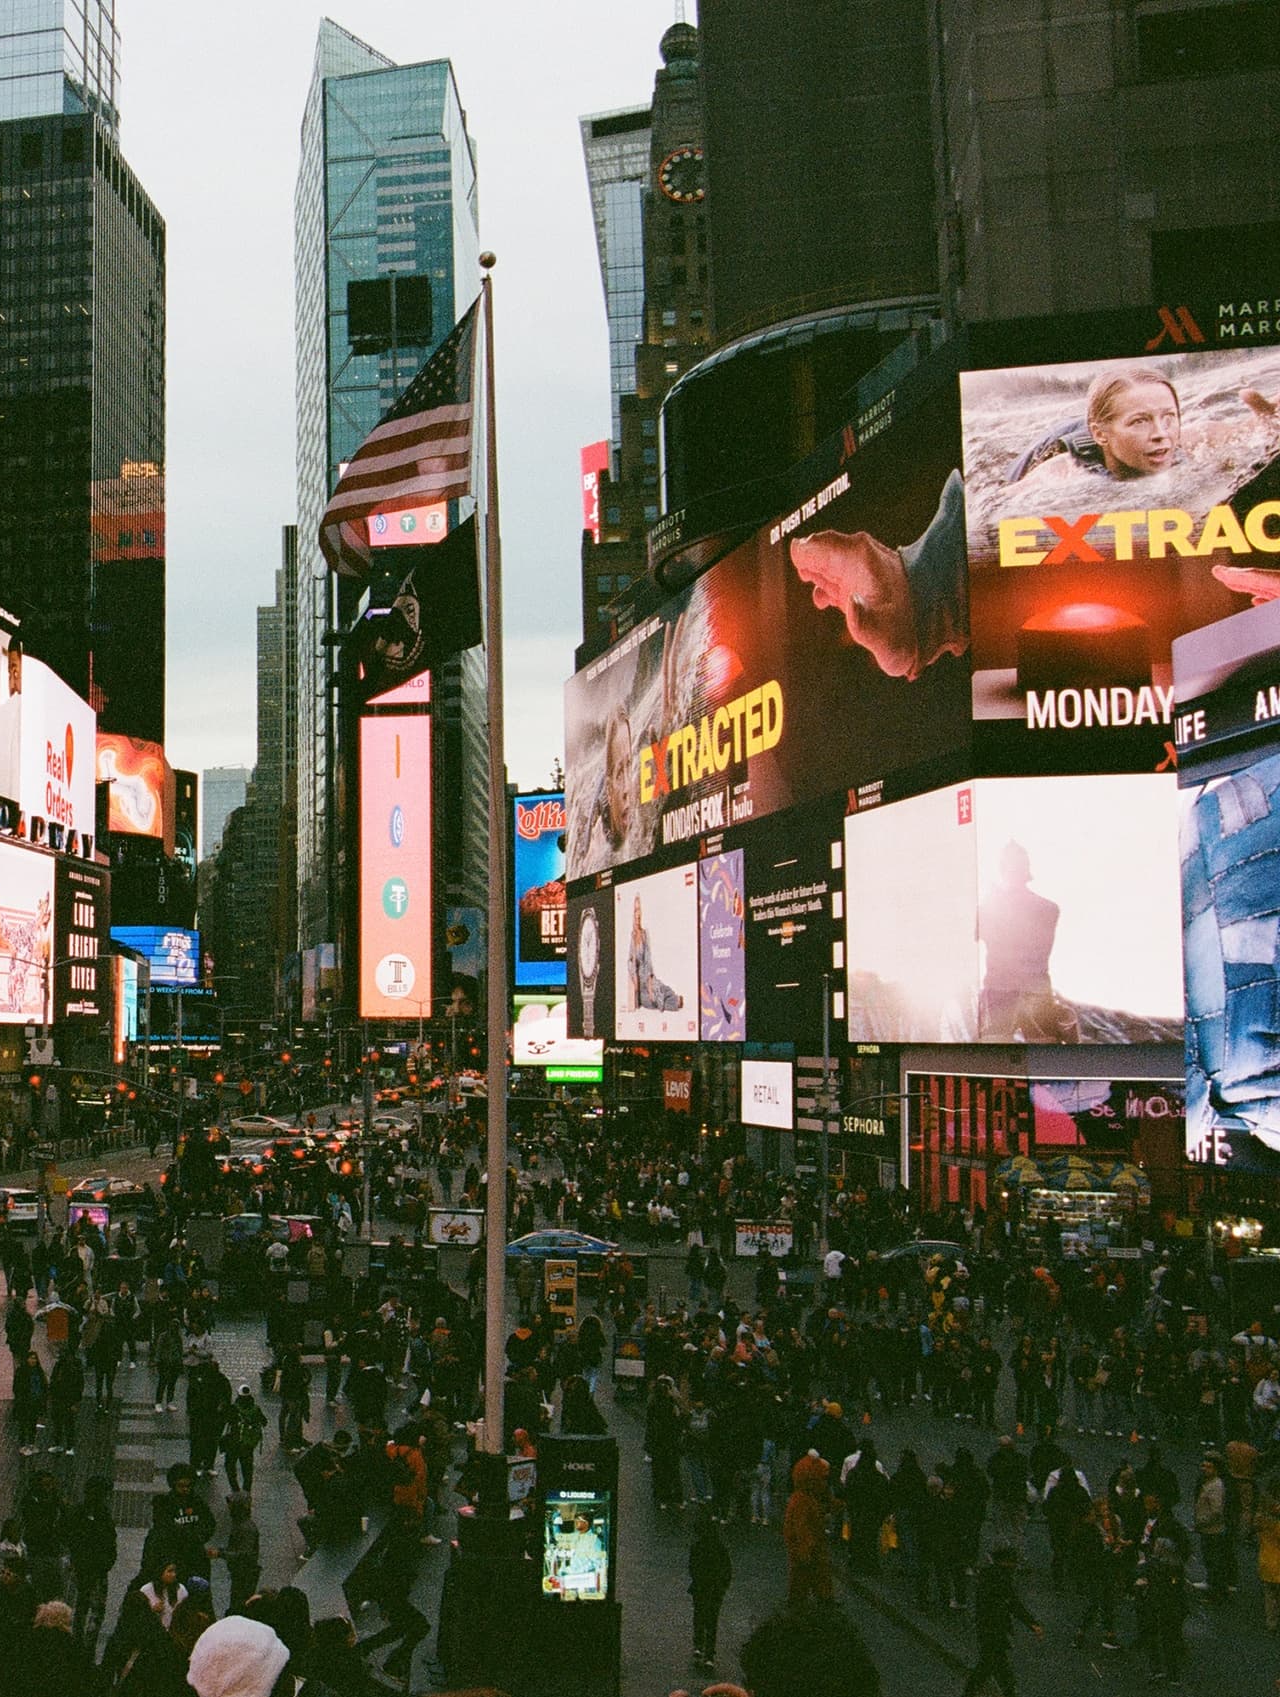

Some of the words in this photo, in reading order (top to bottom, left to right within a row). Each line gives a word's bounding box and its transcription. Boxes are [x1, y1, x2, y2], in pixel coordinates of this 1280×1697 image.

[781, 508, 800, 537] PUSH
[801, 497, 816, 521] THE
[817, 471, 851, 510] BUTTON.
[1026, 685, 1175, 729] MONDAY
[46, 740, 65, 784] Real
[639, 679, 784, 805] EXTRACTED
[45, 780, 73, 828] Orders
[663, 801, 700, 845] MONDAYS
[700, 791, 724, 832] FOX
[733, 795, 753, 821] hulu
[68, 932, 98, 959] BRIGHT
[856, 1044, 880, 1054] SEPHORA
[566, 1069, 599, 1079] FRIENDS
[843, 1116, 885, 1136] SEPHORA
